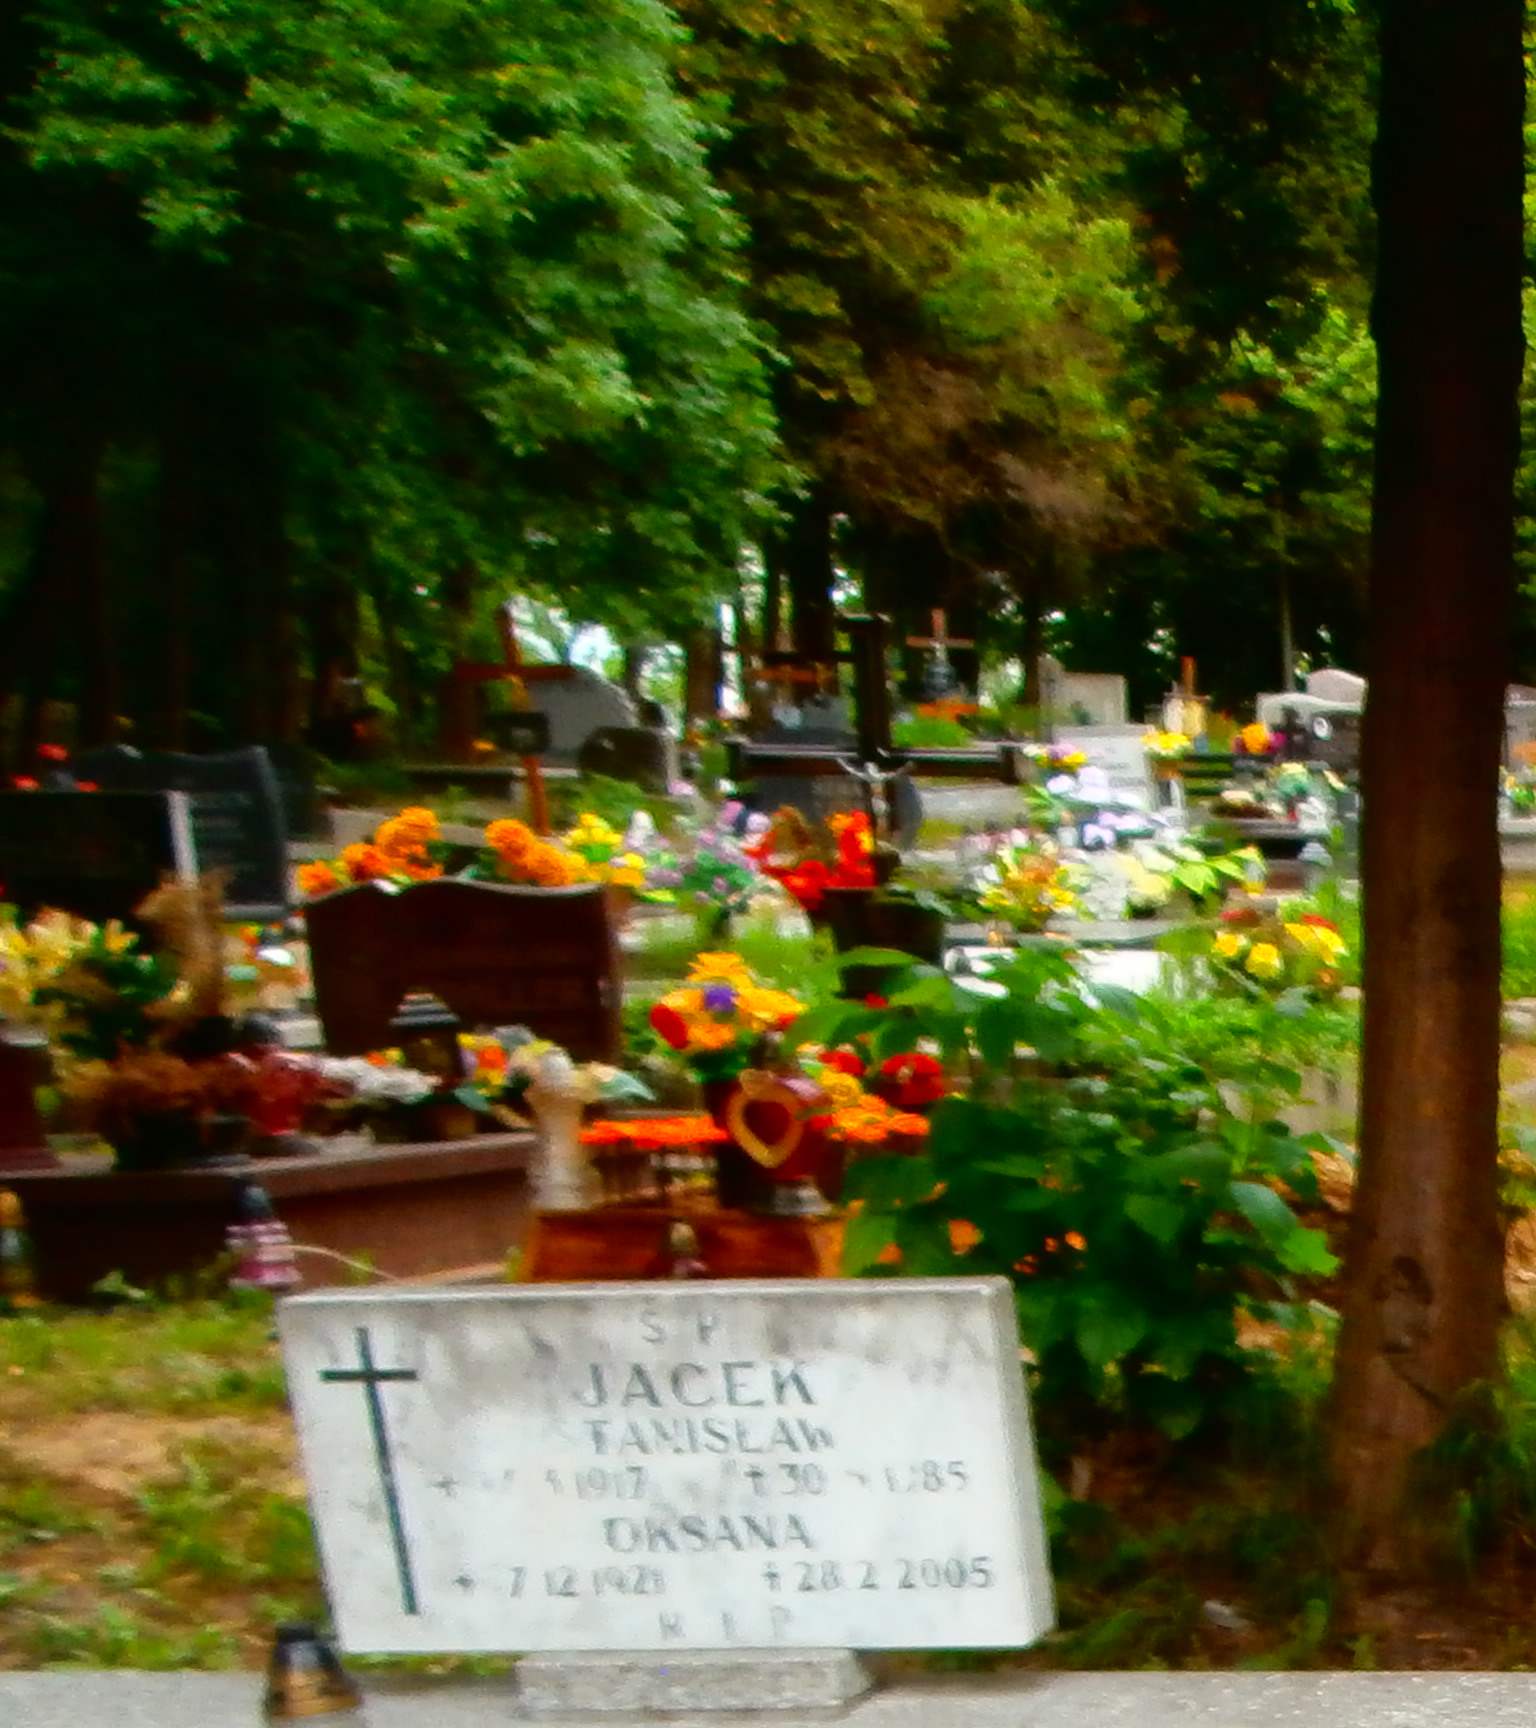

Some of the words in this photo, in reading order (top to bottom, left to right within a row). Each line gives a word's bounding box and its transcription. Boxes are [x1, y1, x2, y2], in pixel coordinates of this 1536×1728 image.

[572, 1361, 818, 1408] JACEK
[603, 1515, 815, 1552] OKSANA
[896, 1555, 997, 1590] 2005
